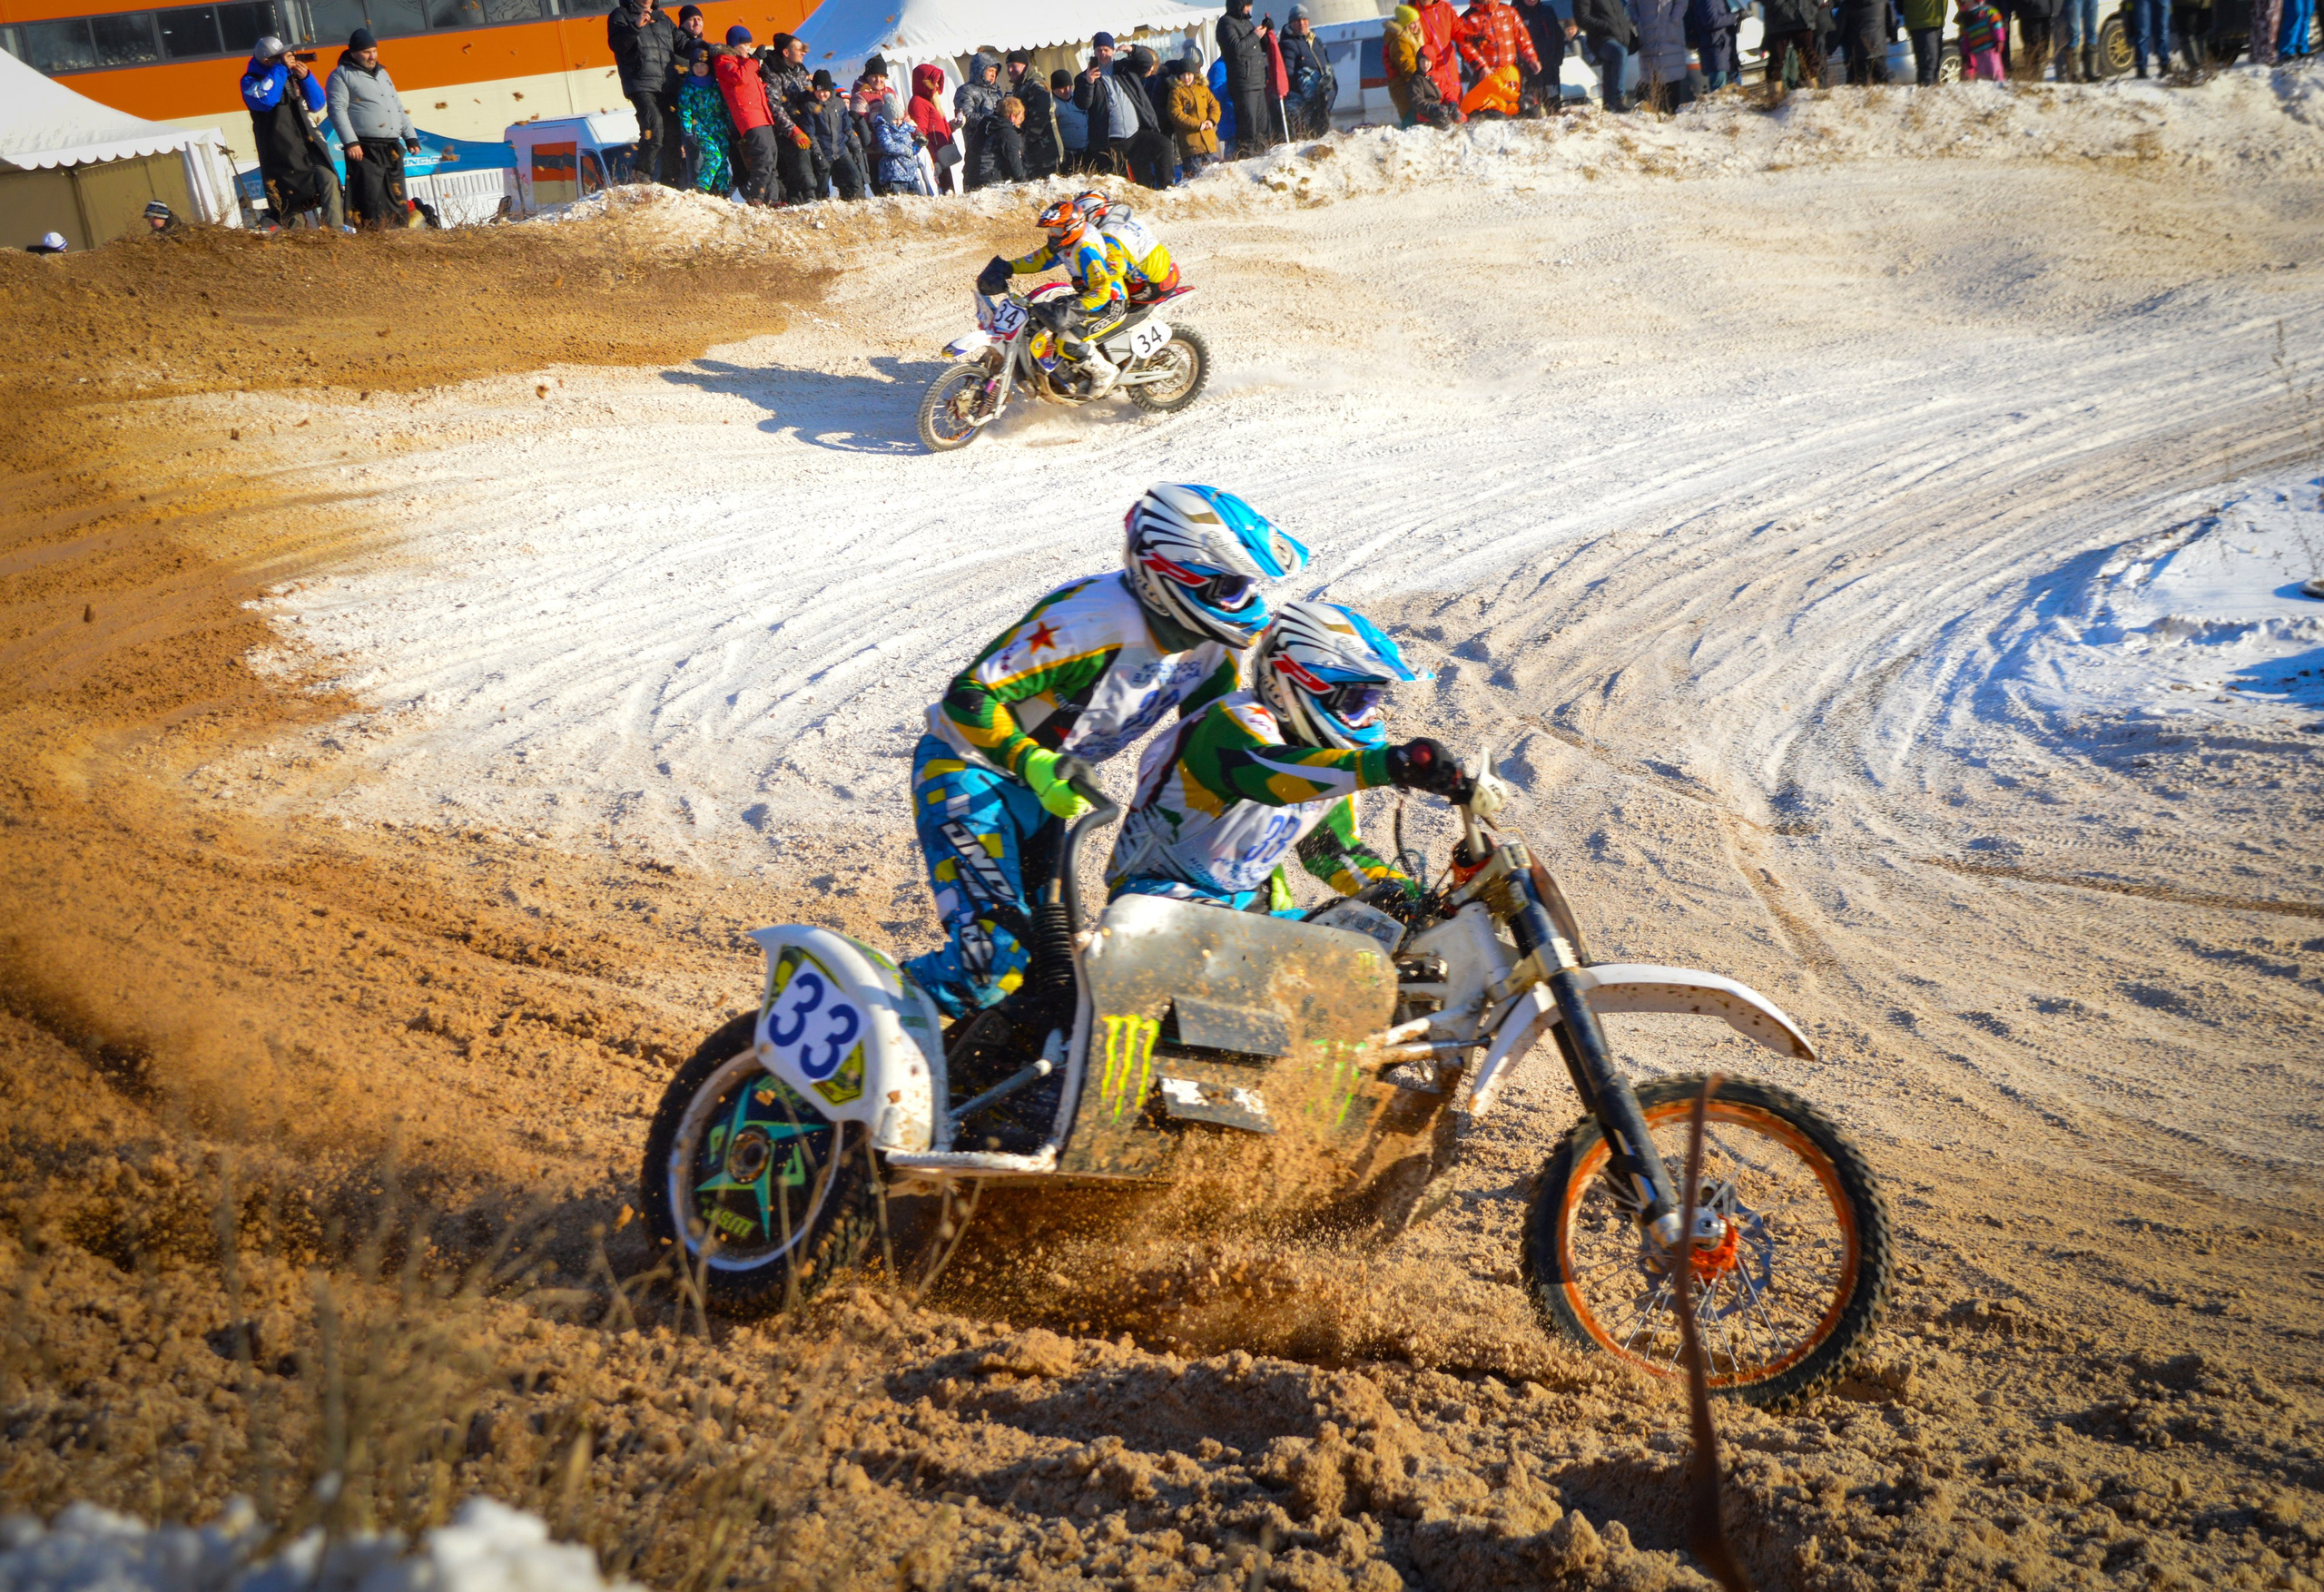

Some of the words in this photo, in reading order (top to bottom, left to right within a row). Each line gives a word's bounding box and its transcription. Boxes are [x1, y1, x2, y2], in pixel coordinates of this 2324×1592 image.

[994, 303, 1020, 329] 34
[1137, 325, 1164, 354] 34
[1244, 814, 1302, 864] 33
[768, 972, 859, 1079] 33
